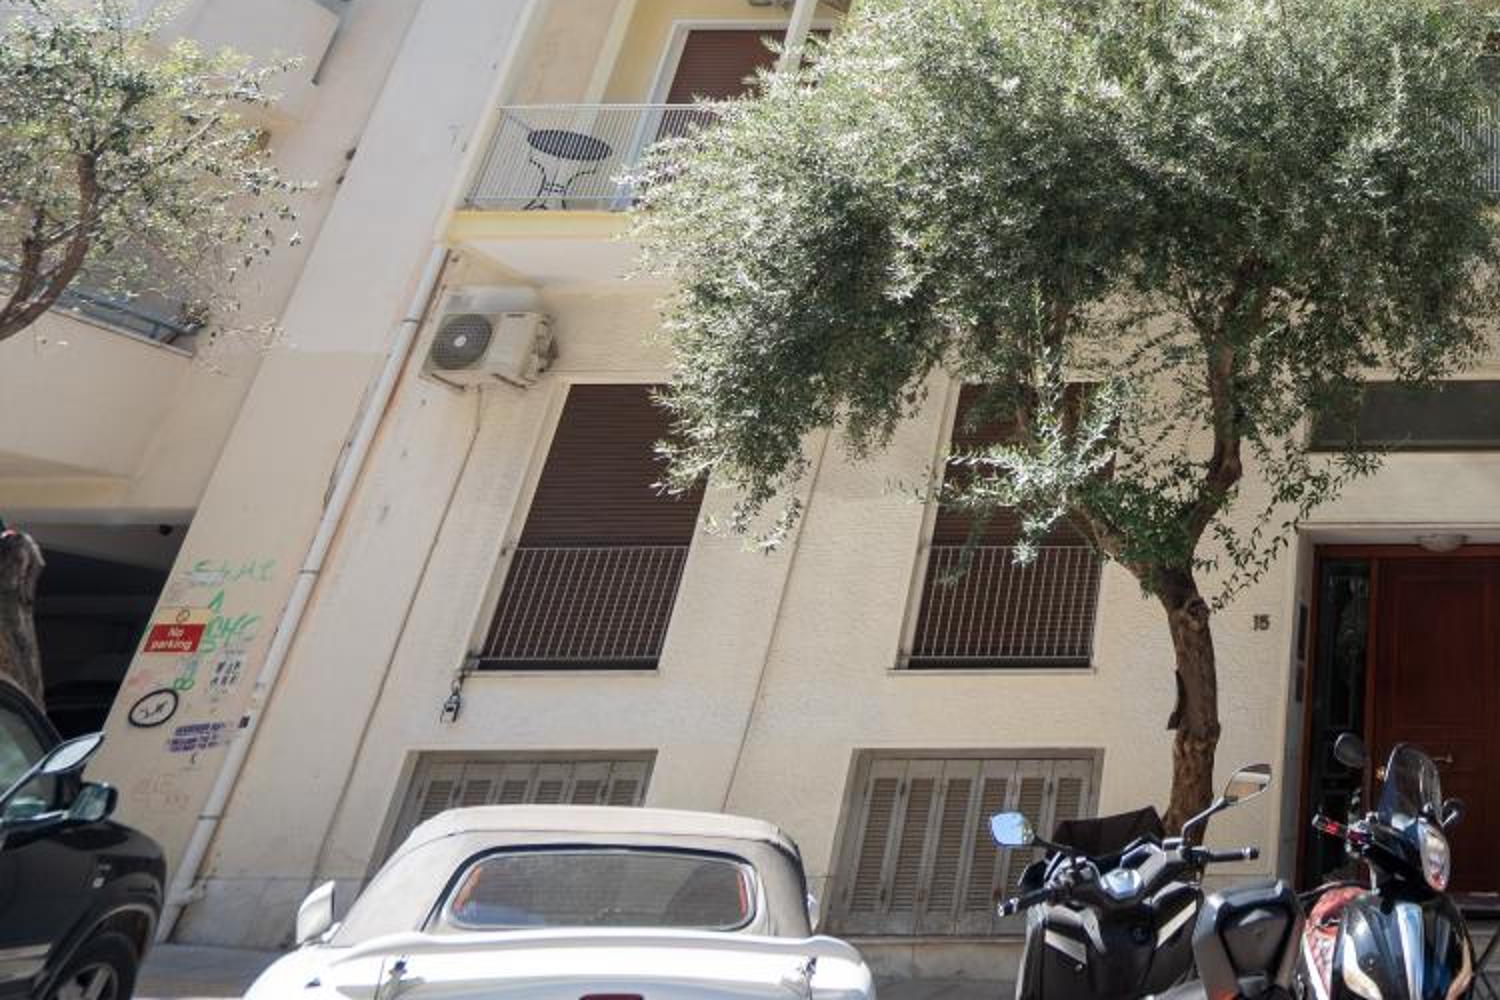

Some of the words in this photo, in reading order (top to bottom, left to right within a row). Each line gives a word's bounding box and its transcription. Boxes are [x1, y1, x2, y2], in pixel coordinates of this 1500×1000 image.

[1253, 614, 1270, 631] 15
[167, 626, 185, 637] No
[150, 638, 193, 651] parking
